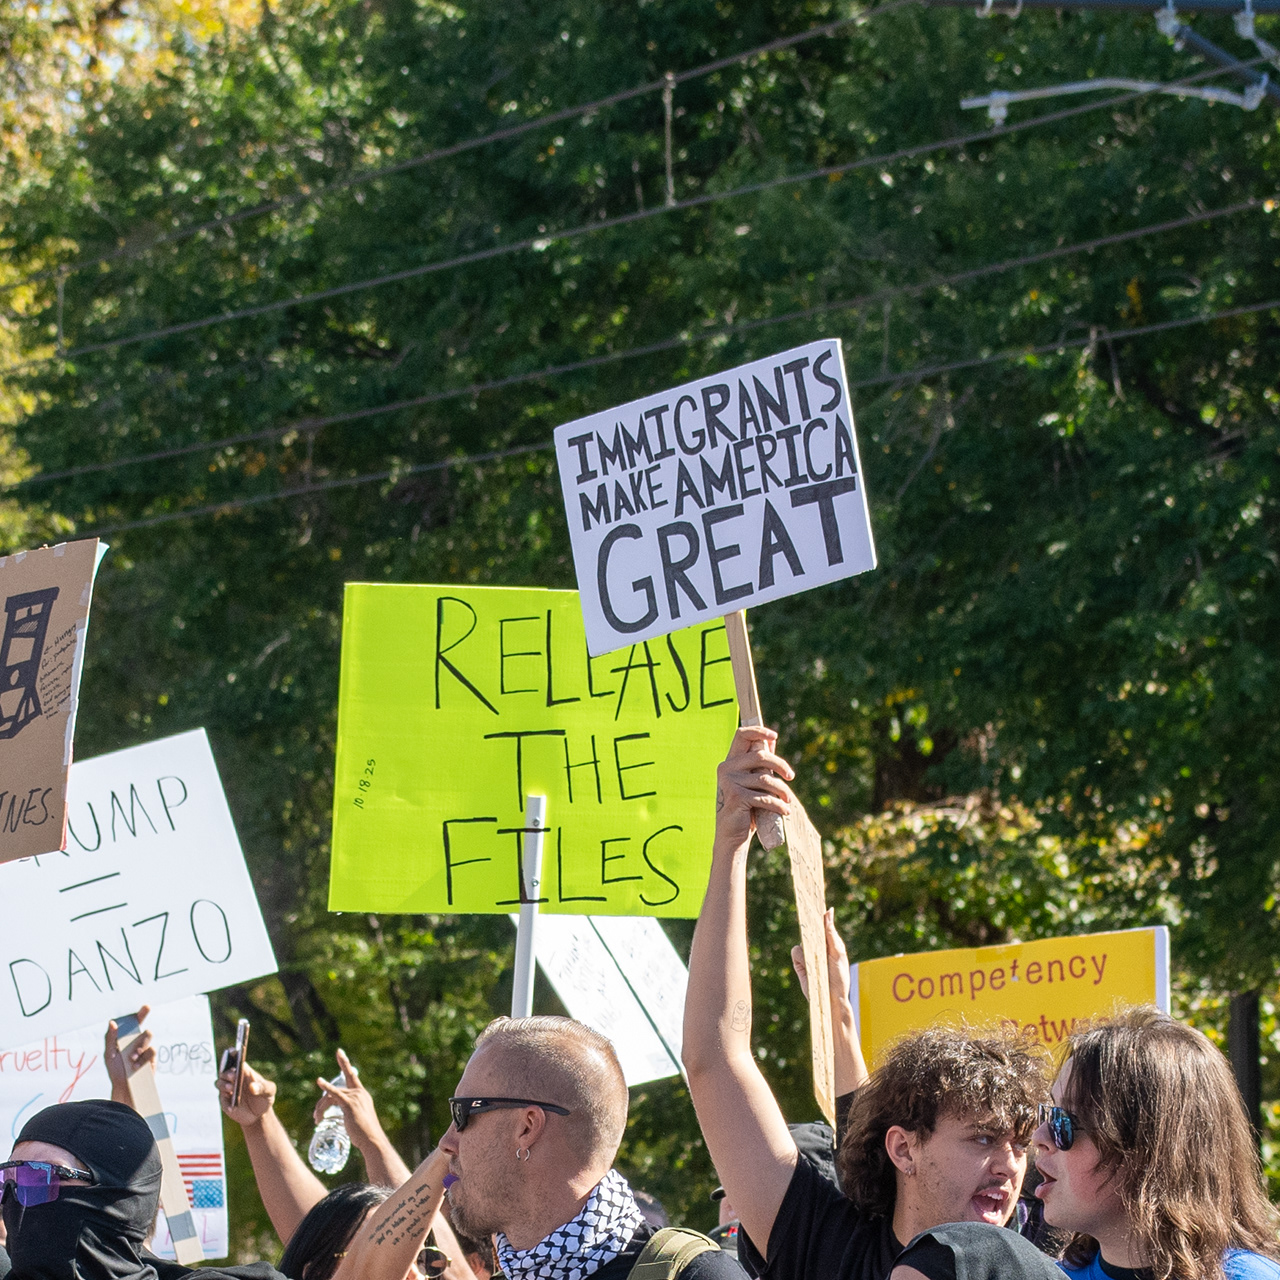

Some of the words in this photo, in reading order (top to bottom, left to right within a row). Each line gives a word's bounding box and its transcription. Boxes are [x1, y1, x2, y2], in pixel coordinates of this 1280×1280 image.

[568, 349, 841, 485] IMMIGRANTS
[579, 463, 669, 532] MAKE
[673, 413, 858, 518] AMERICA
[597, 476, 856, 634] GREAT
[435, 596, 734, 721] RELEASE
[483, 729, 657, 812] THE
[443, 816, 683, 906] FILES
[9, 899, 232, 1017] DANZO
[892, 953, 1108, 1003] Competency
